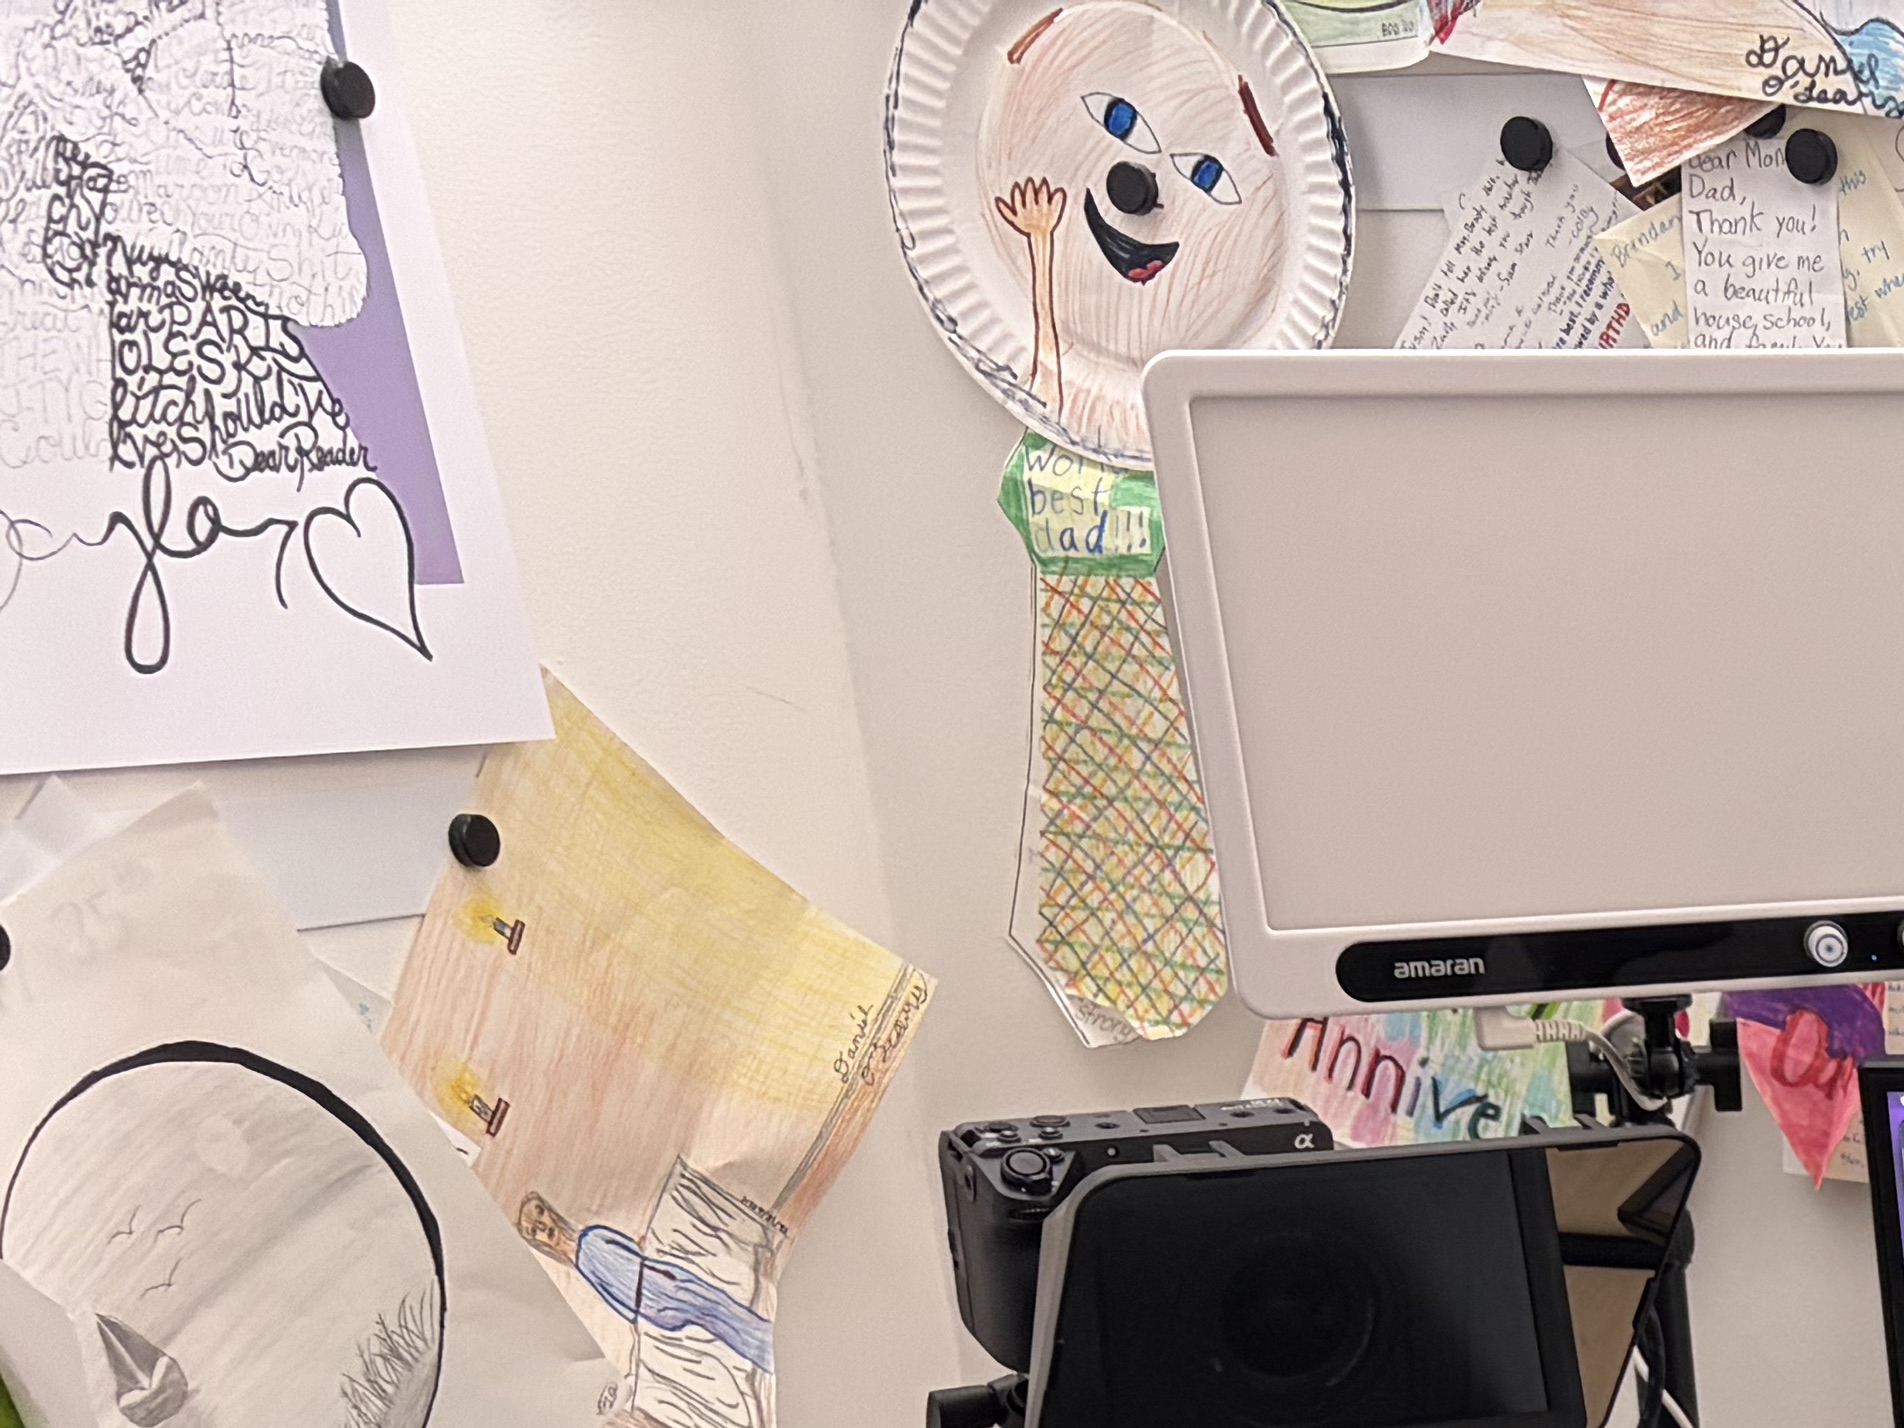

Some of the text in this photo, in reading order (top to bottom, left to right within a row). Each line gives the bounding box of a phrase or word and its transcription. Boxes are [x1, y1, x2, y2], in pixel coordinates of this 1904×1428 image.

[1688, 175, 1746, 204] Dad,
[1688, 203, 1817, 238] Thank you!
[1693, 240, 1824, 278] You give me
[1695, 275, 1813, 307] a beautiful
[1026, 477, 1110, 517] best
[1394, 957, 1486, 979] amaran
